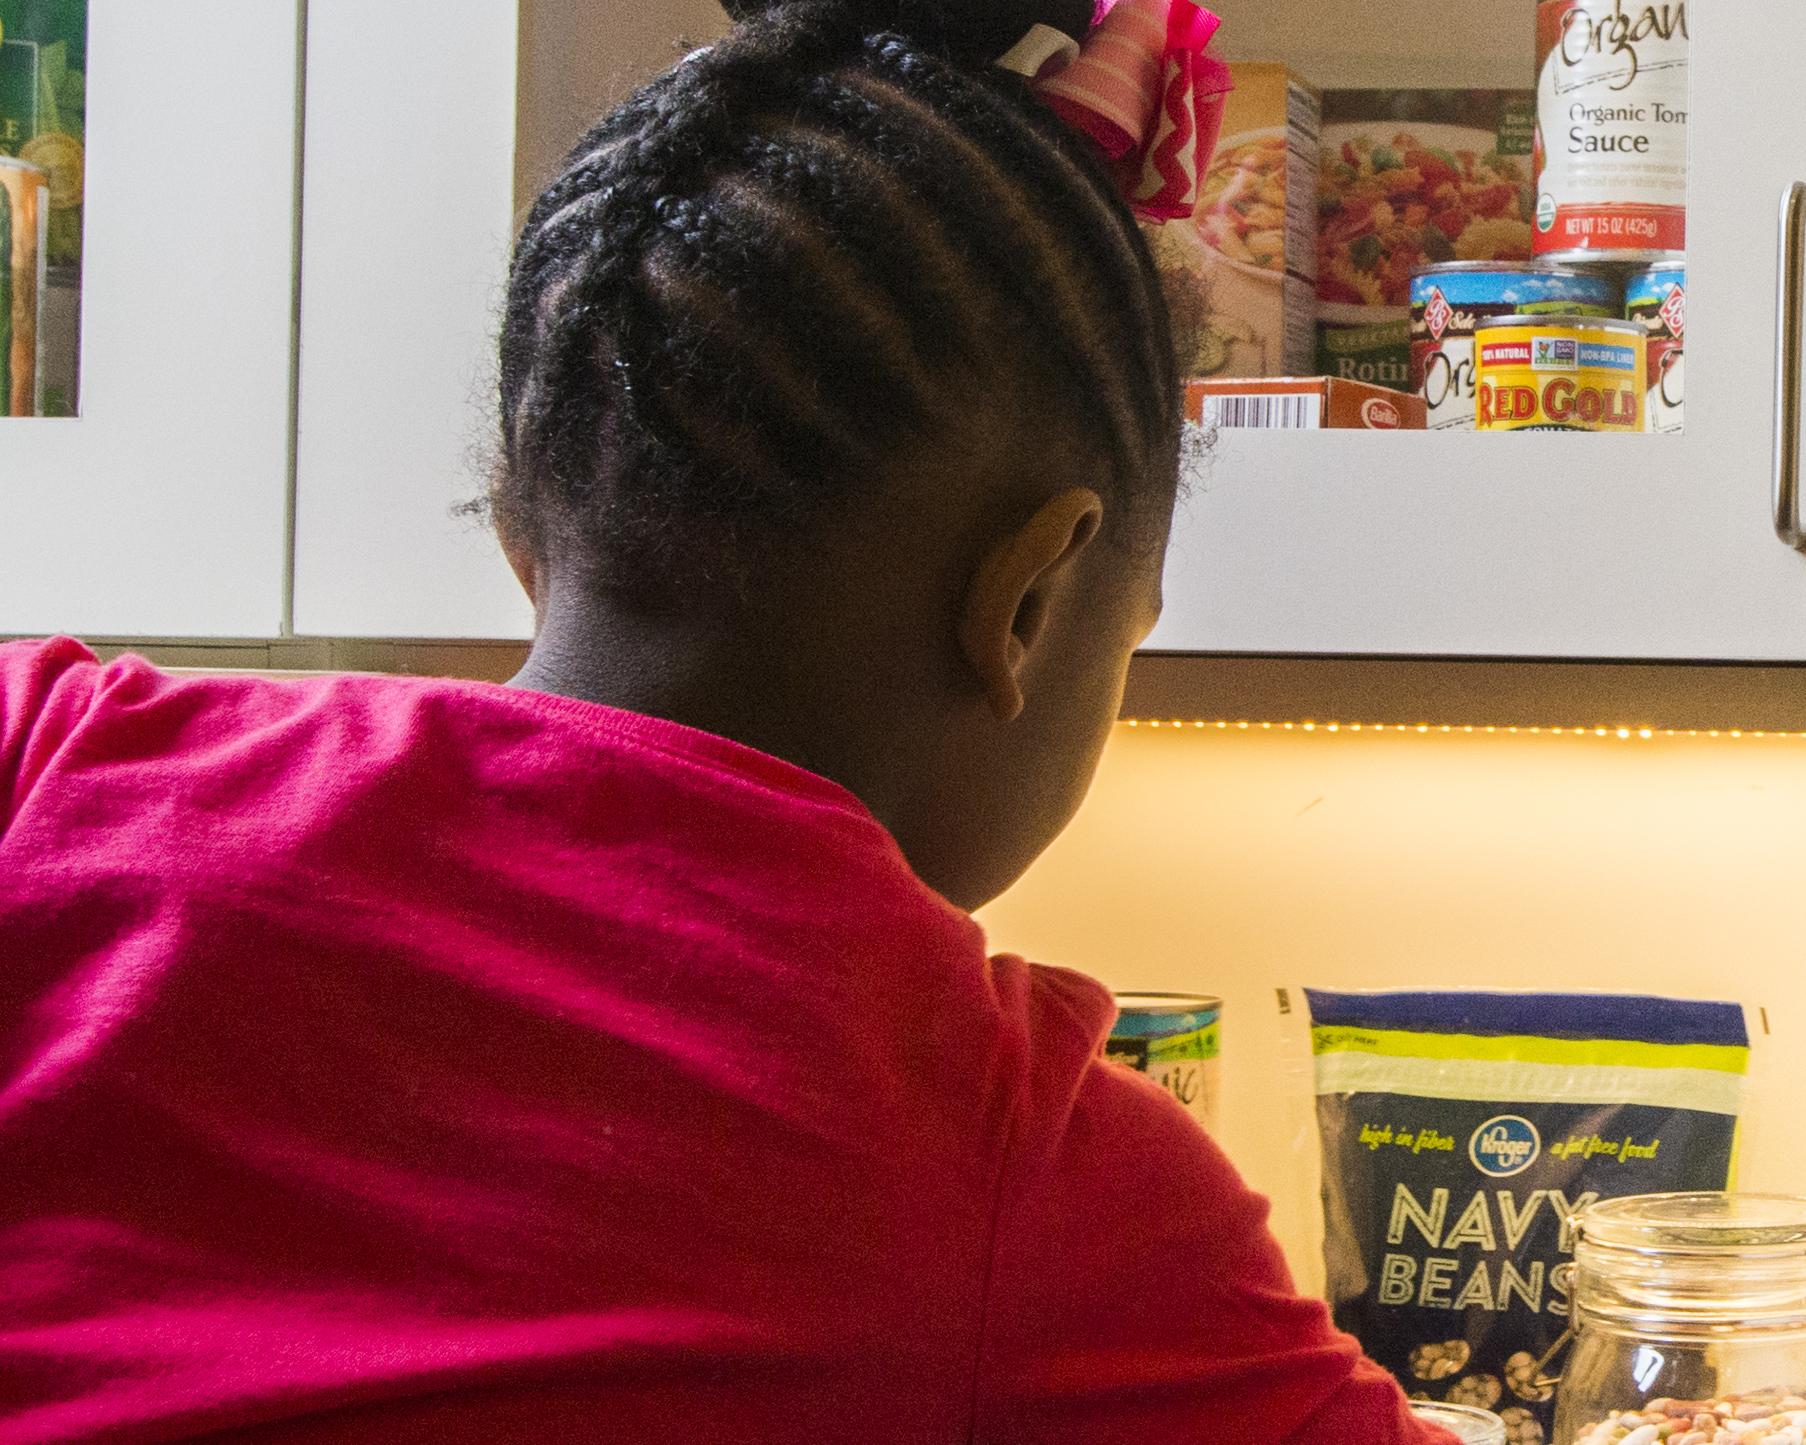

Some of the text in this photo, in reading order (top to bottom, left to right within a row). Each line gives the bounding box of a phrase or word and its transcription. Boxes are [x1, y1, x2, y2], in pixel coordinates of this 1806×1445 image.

[1568, 102, 1646, 127] Organic
[1567, 126, 1650, 154] Sauce
[1565, 217, 1658, 238] NET WT 15 OZ (425g)
[1494, 347, 1530, 360] NATURAL
[1479, 377, 1638, 428] RED GOLD
[1480, 1126, 1533, 1168] Kroger
[1386, 1183, 1598, 1253] NAVY
[1378, 1252, 1574, 1317] BEANS
